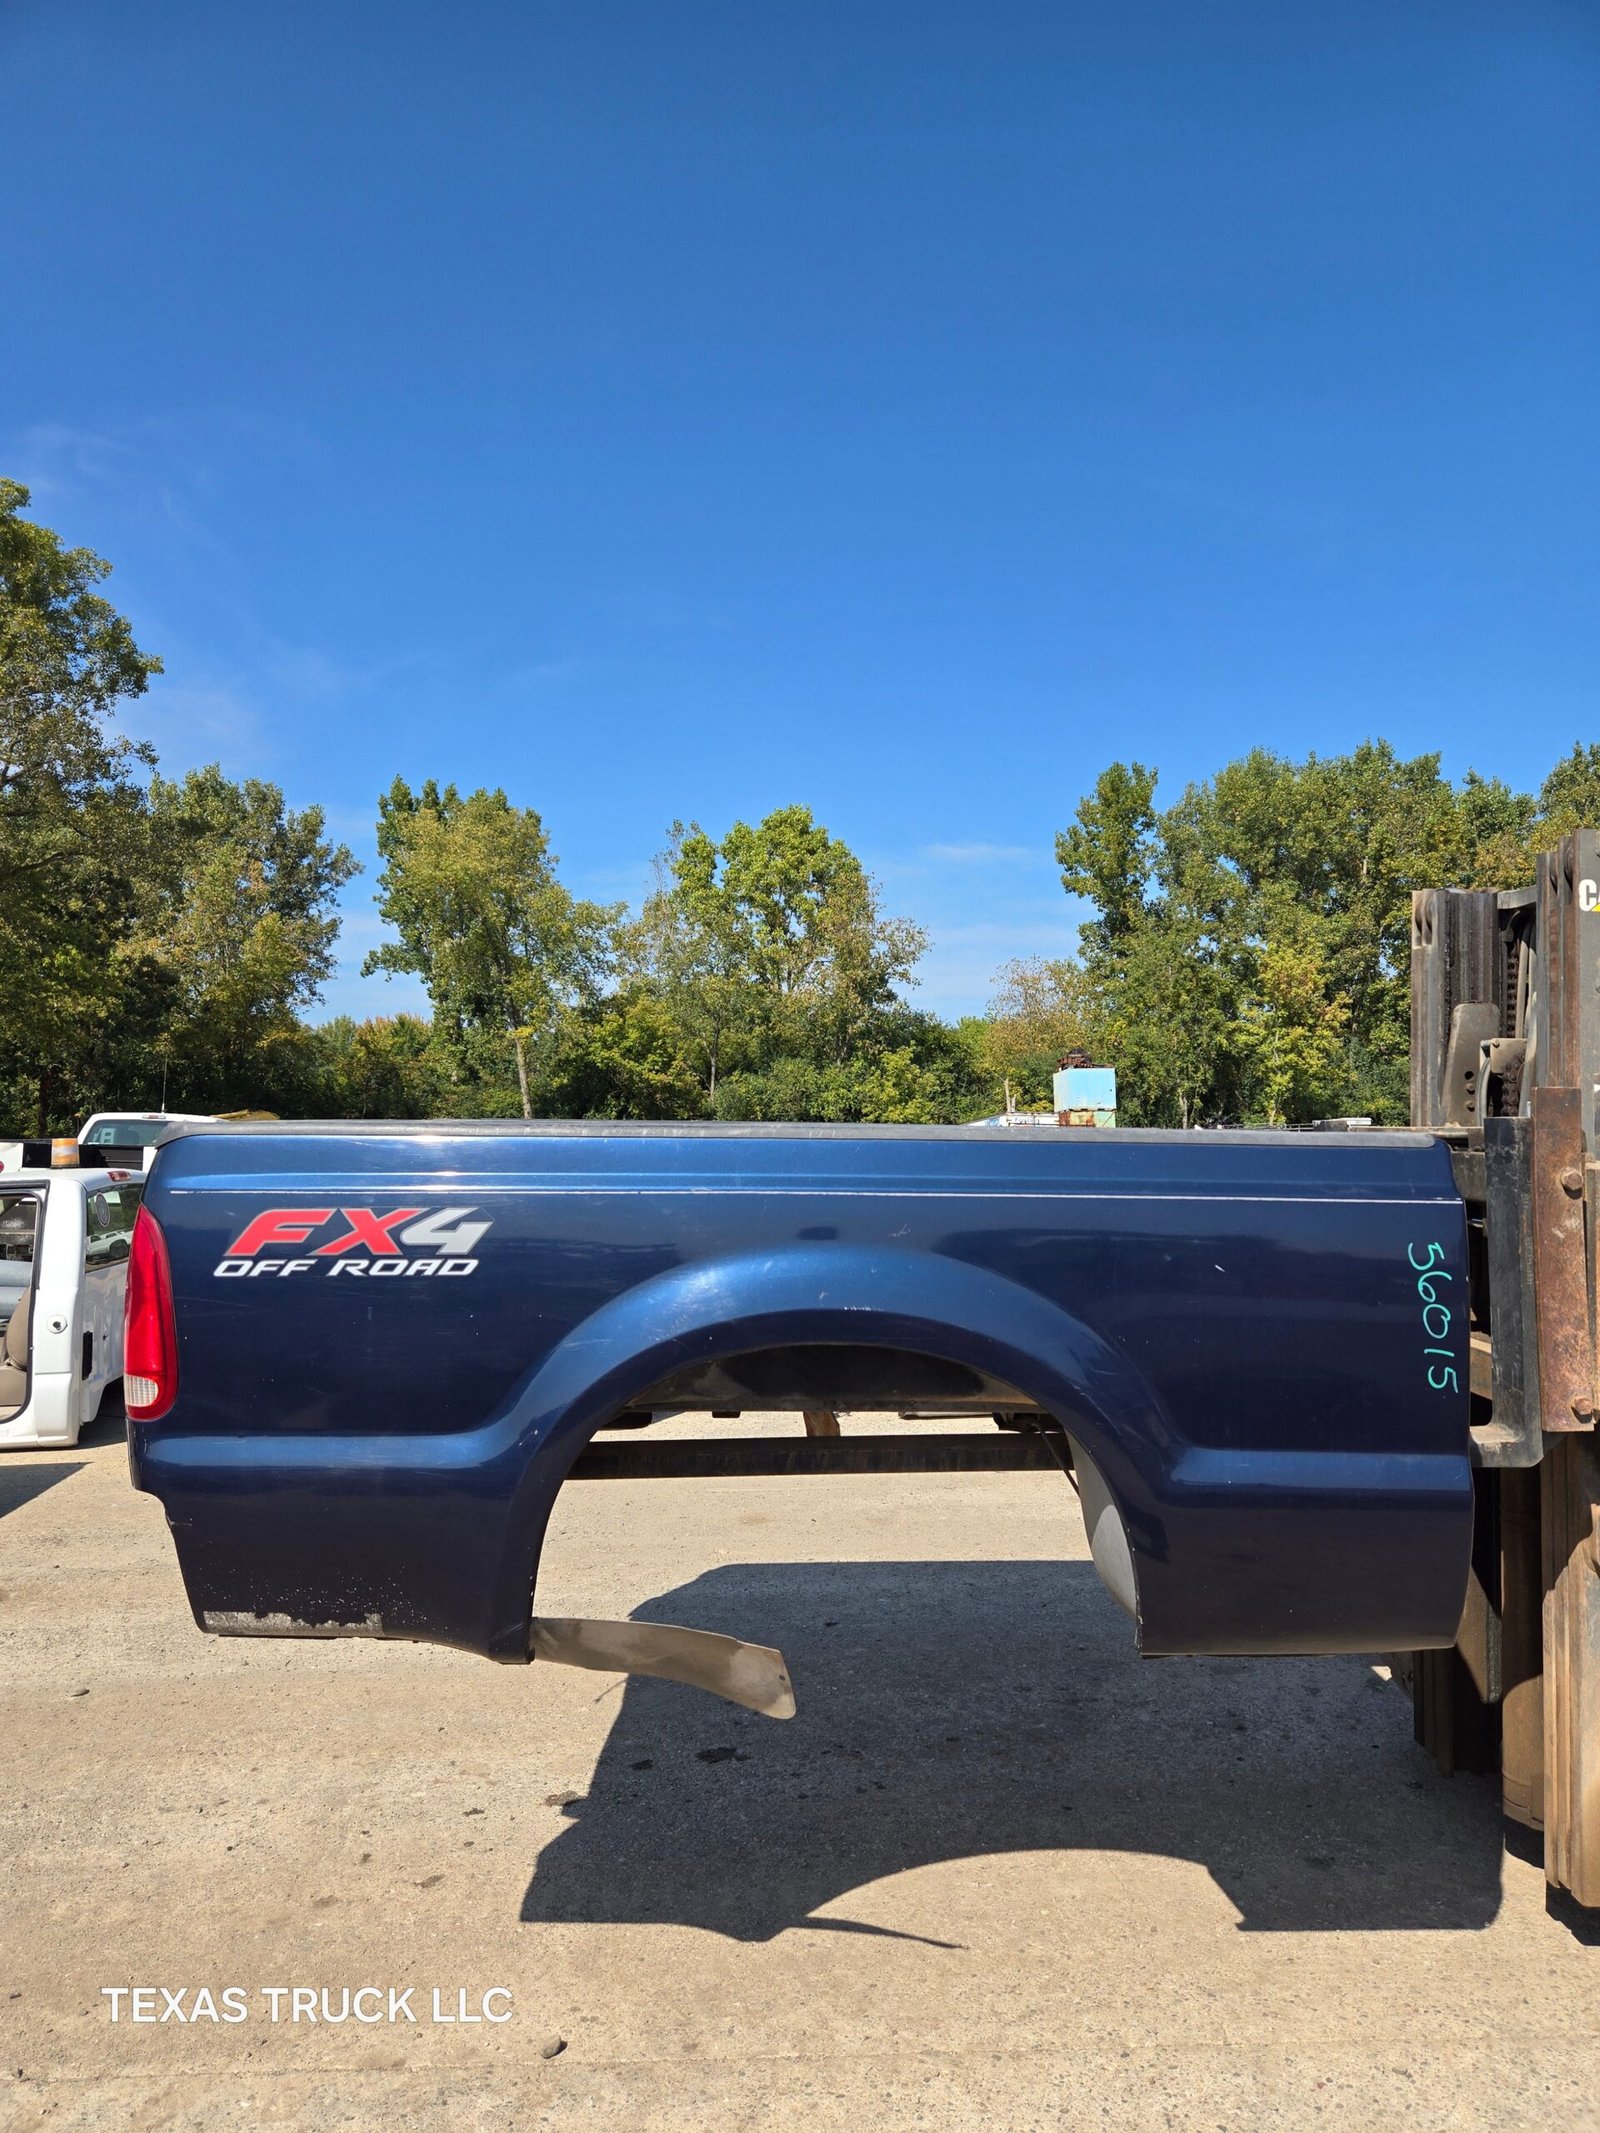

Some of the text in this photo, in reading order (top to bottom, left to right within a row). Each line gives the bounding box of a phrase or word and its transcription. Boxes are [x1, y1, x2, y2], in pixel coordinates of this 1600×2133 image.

[223, 1207, 494, 1256] FX4
[213, 1258, 479, 1277] OFF ROAD
[1407, 1242, 1458, 1394] 56015
